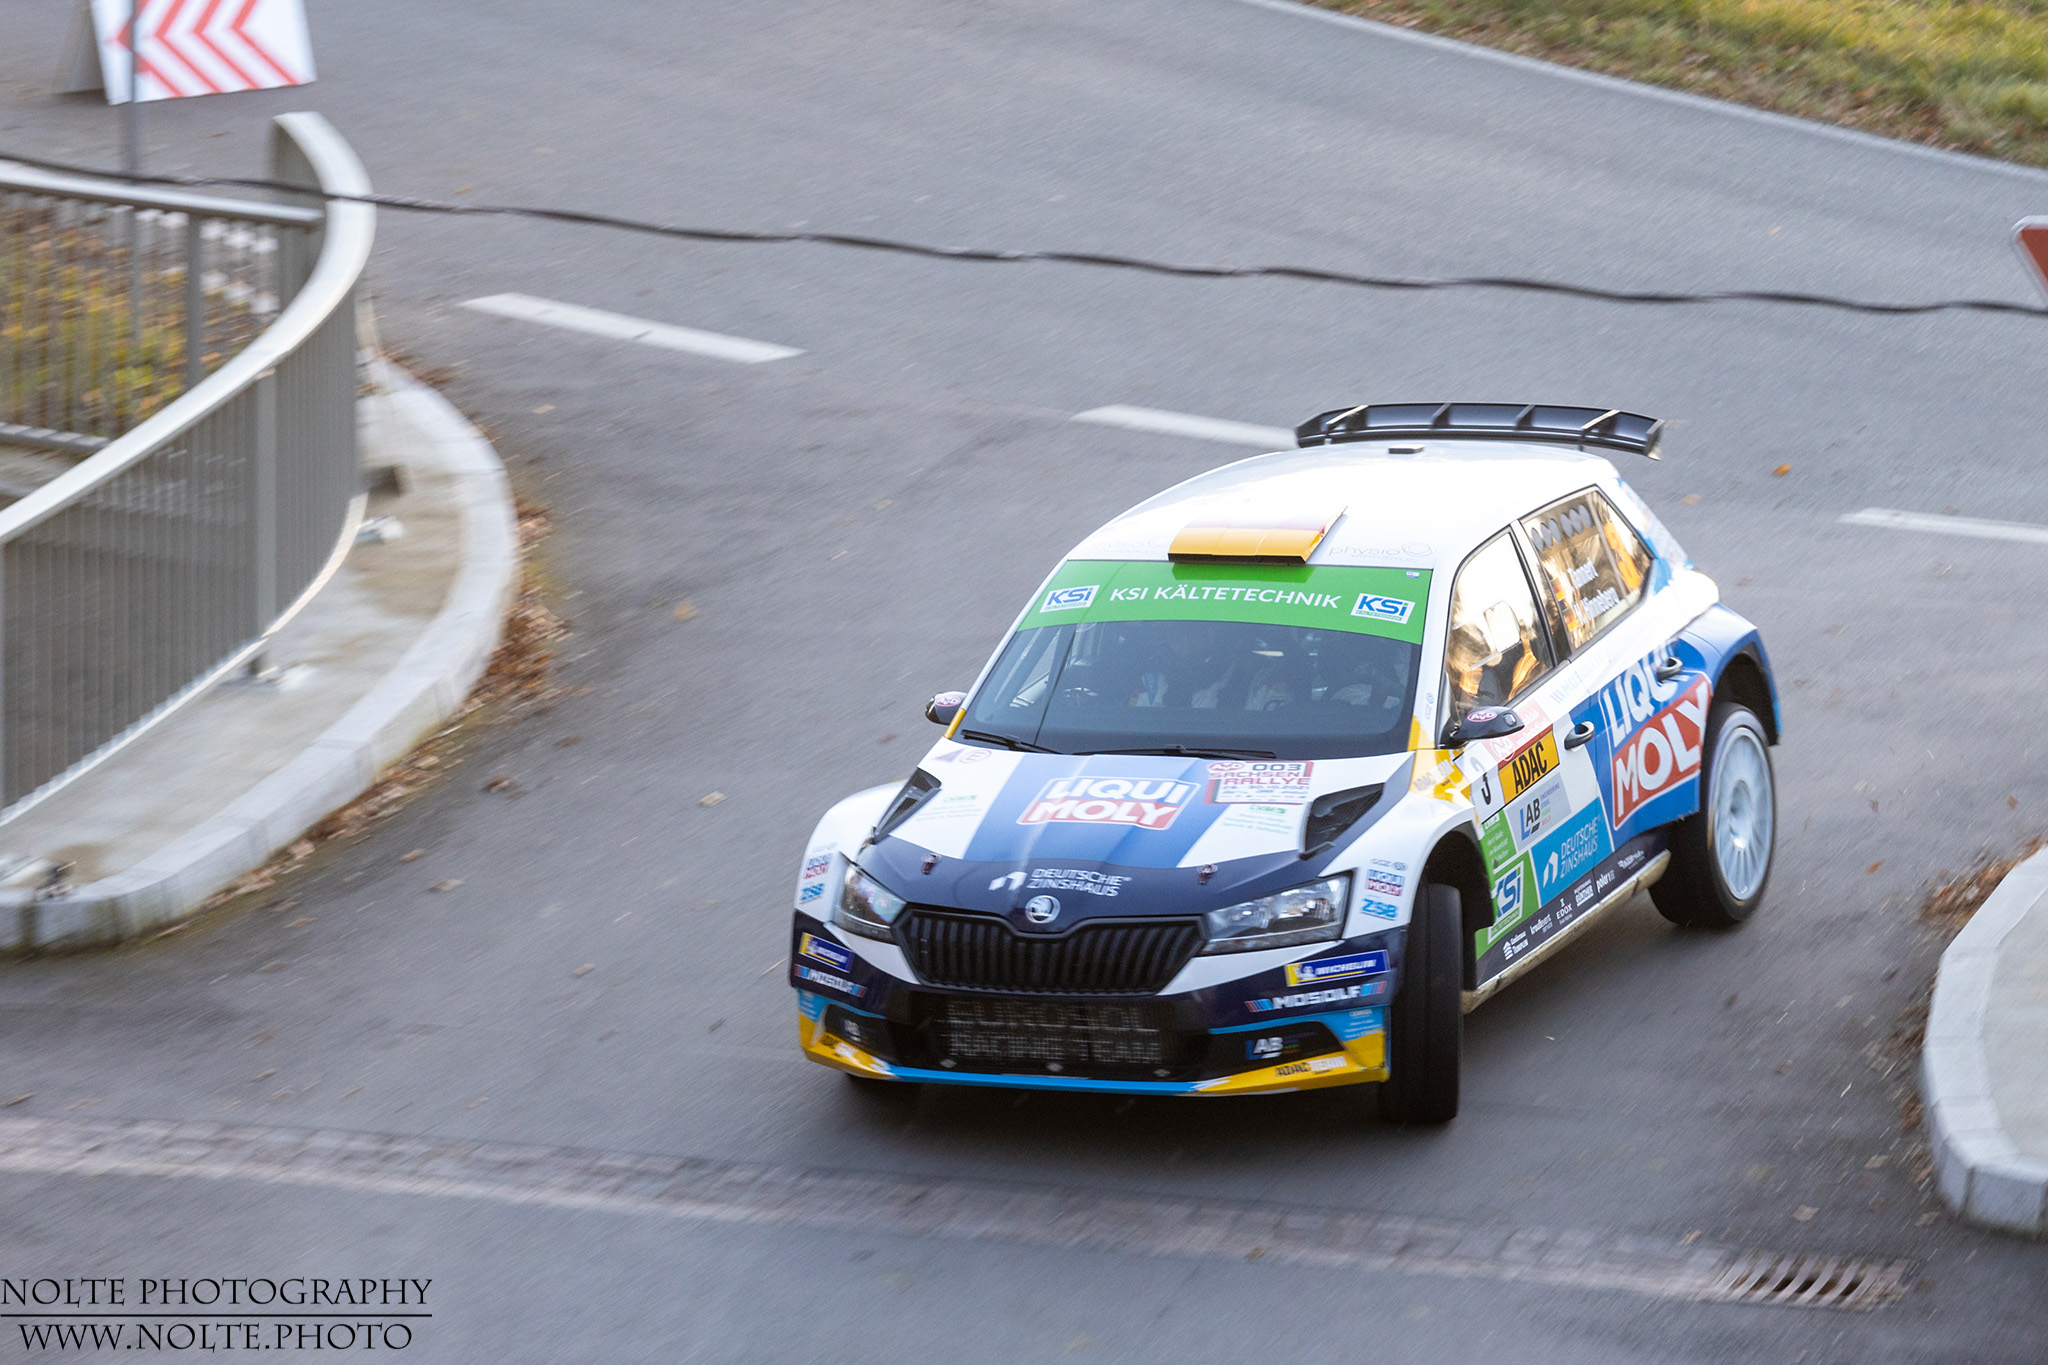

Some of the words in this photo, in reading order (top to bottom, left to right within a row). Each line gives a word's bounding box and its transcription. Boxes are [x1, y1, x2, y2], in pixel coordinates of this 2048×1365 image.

[1110, 586, 1149, 601] KSI
[1154, 584, 1342, 609] KÄLTETECHNIK
[1616, 680, 1710, 818] MOLY
[1511, 741, 1548, 794] ADAC
[1045, 779, 1191, 804] LIQUI
[1027, 799, 1181, 826] MOLY
[1561, 817, 1599, 859] DEUTSCHE
[1560, 836, 1598, 879] ZINSHAUS
[1026, 878, 1121, 897] ZINSHAUS
[1031, 868, 1124, 887] DEUTSCHE
[1362, 898, 1398, 918] ZSB
[1556, 903, 1573, 920] EDOX
[1315, 959, 1377, 976] MICHELIN
[1273, 985, 1362, 1009] MOSOLF
